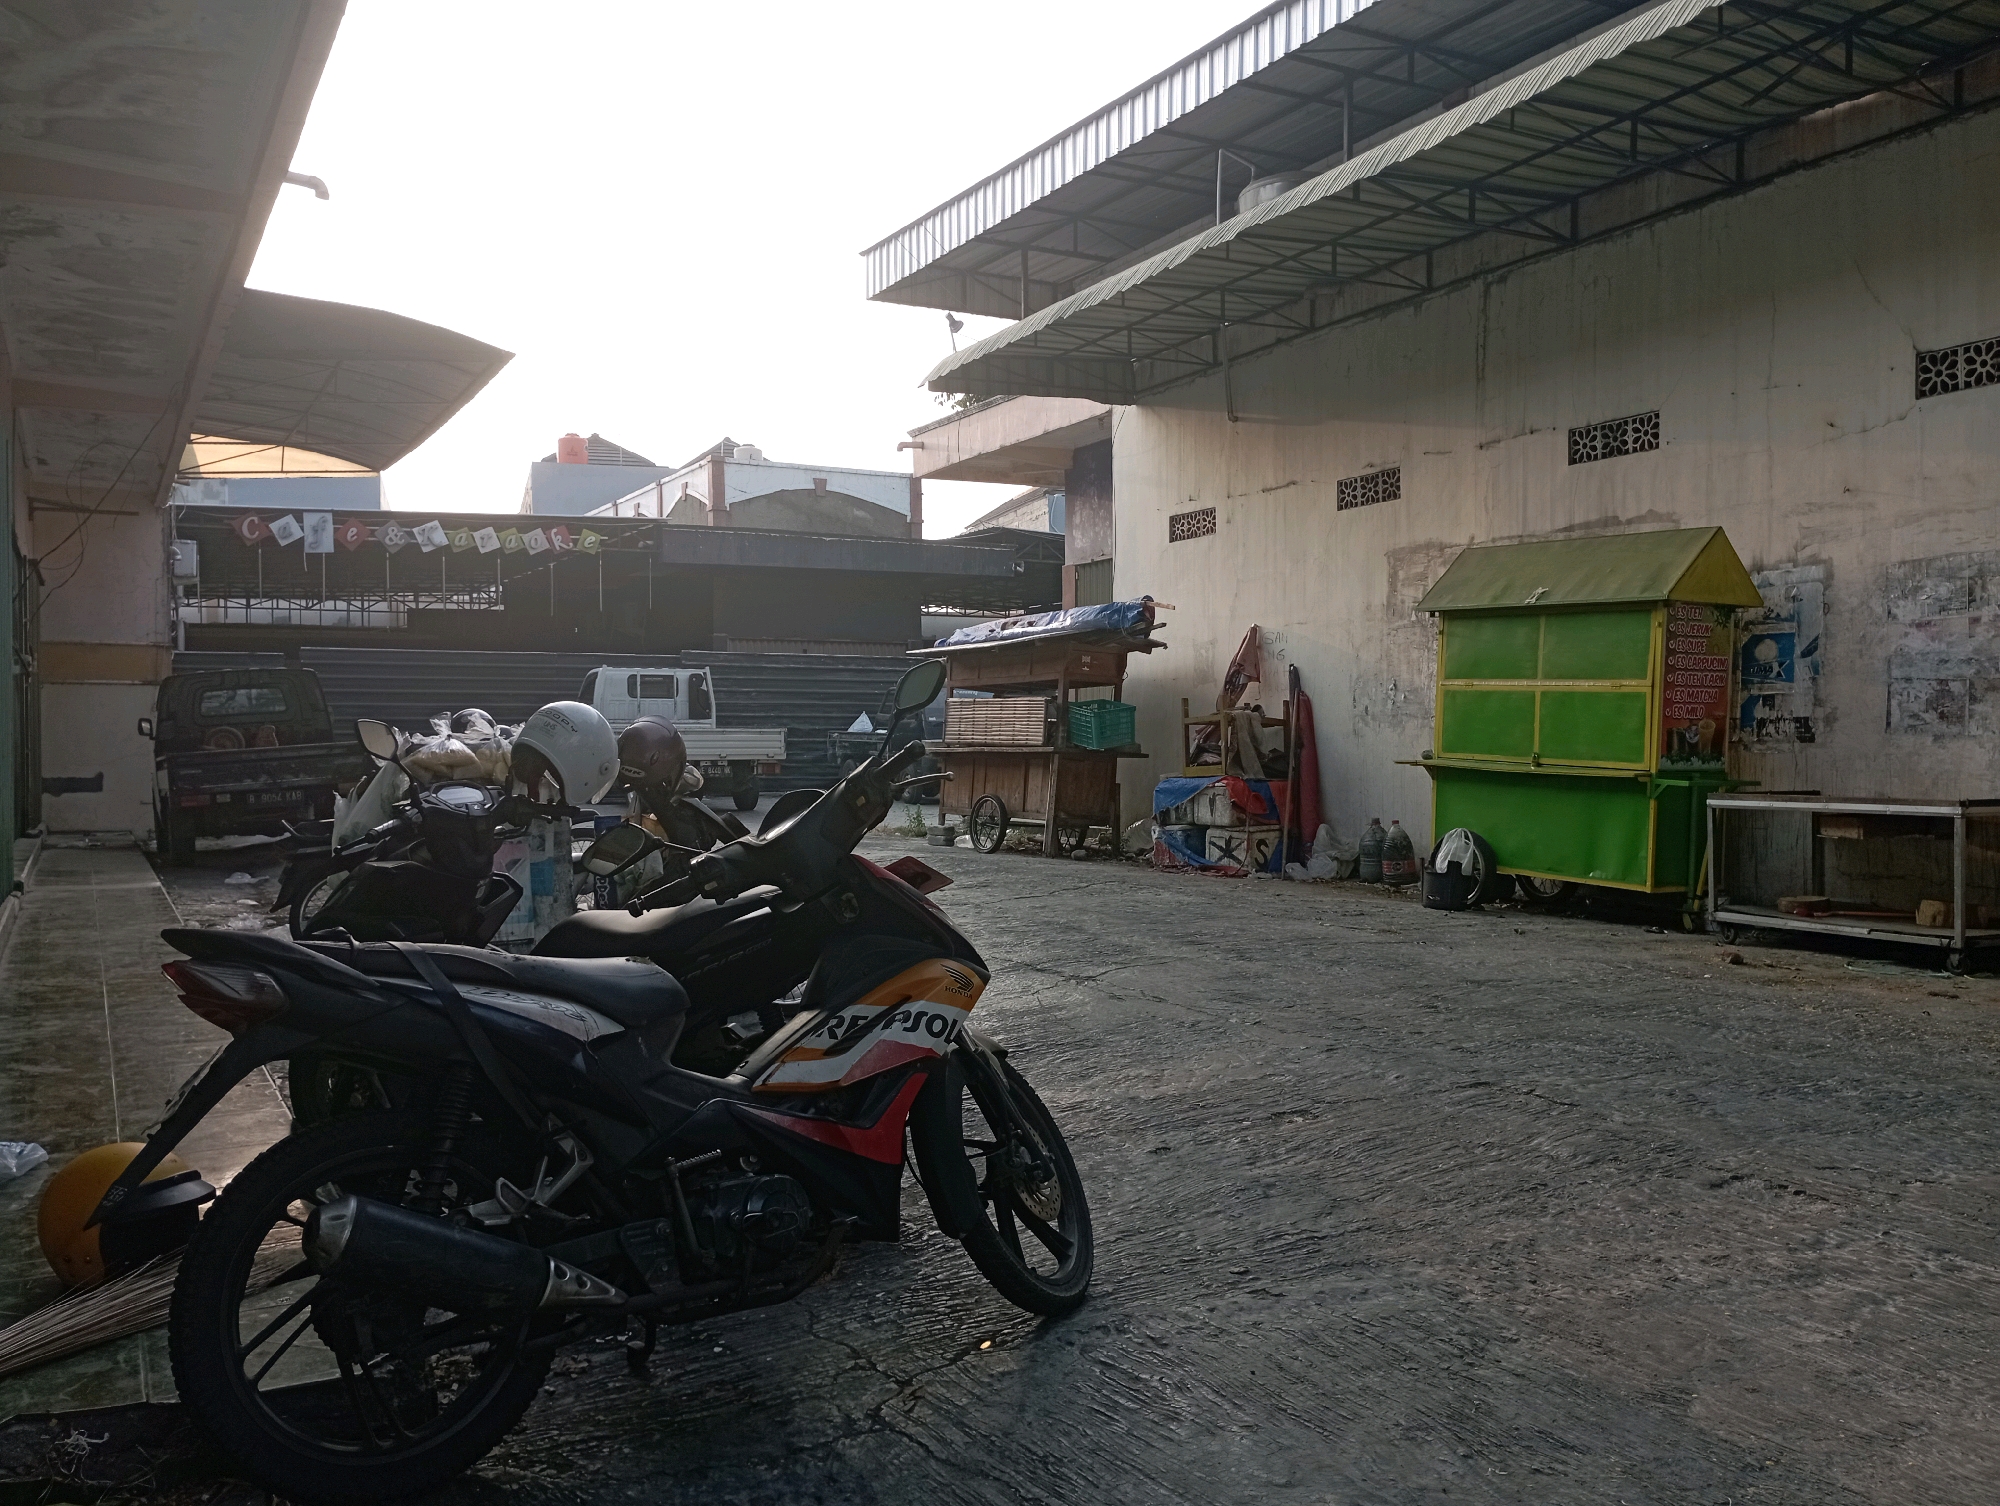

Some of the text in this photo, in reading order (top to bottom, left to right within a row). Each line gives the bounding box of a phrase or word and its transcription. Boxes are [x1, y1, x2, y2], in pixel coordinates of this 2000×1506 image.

[241, 516, 597, 551] Cafe & Karaoke
[1676, 605, 1704, 620] ES TEH
[1676, 621, 1712, 636] ES JERUK
[1676, 638, 1686, 652] ES
[1675, 654, 1686, 668] ES
[1675, 671, 1726, 687] ES TEH TARIK
[1673, 688, 1719, 703] ES MATCHA
[1673, 704, 1705, 719] ES MILO
[944, 985, 973, 1000] HONDA
